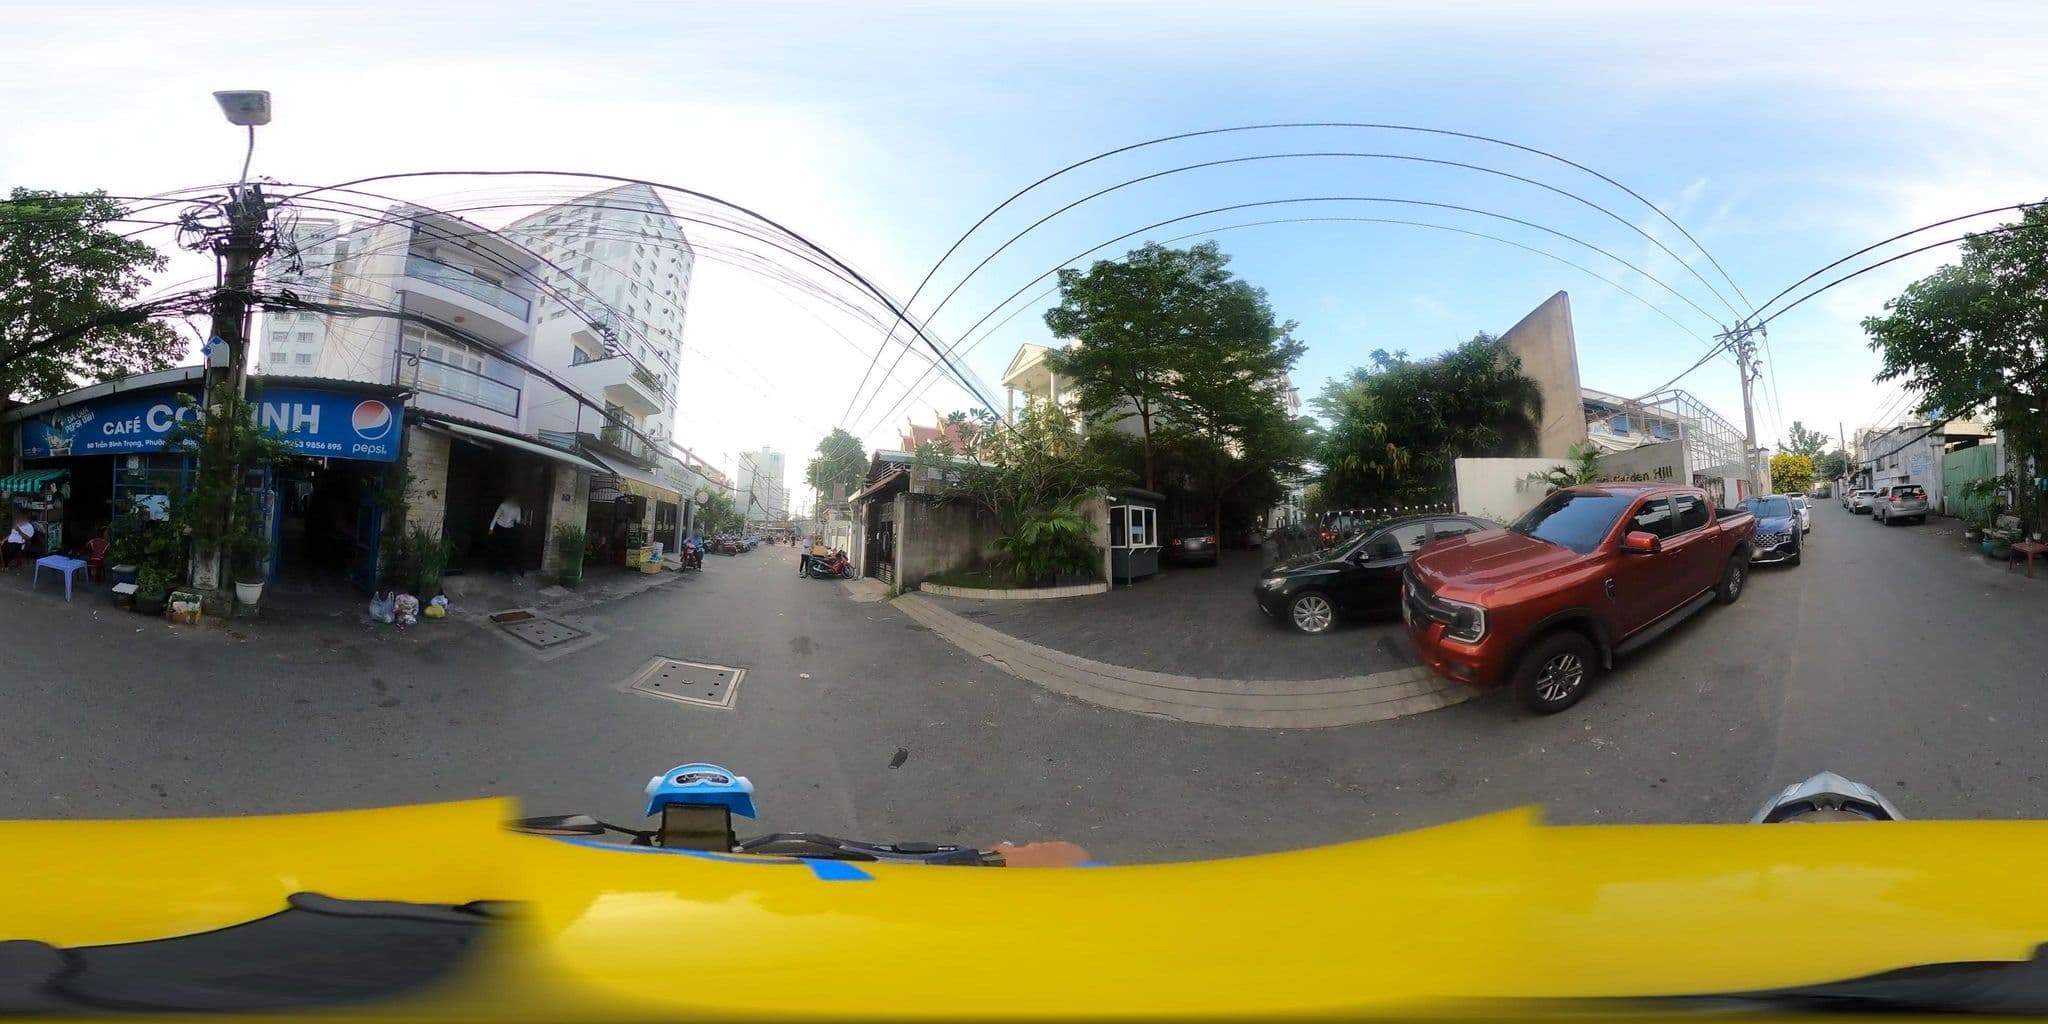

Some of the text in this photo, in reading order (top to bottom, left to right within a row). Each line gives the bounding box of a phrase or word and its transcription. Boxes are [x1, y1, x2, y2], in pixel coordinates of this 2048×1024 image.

[65, 418, 82, 434] PEPSI
[102, 415, 141, 436] CAFÉ
[109, 440, 123, 448] Bình
[123, 440, 144, 448] Trọng,
[305, 441, 326, 449] 9856
[327, 442, 342, 450] 895
[352, 443, 383, 454] pepsi
[1653, 465, 1673, 479] Hill
